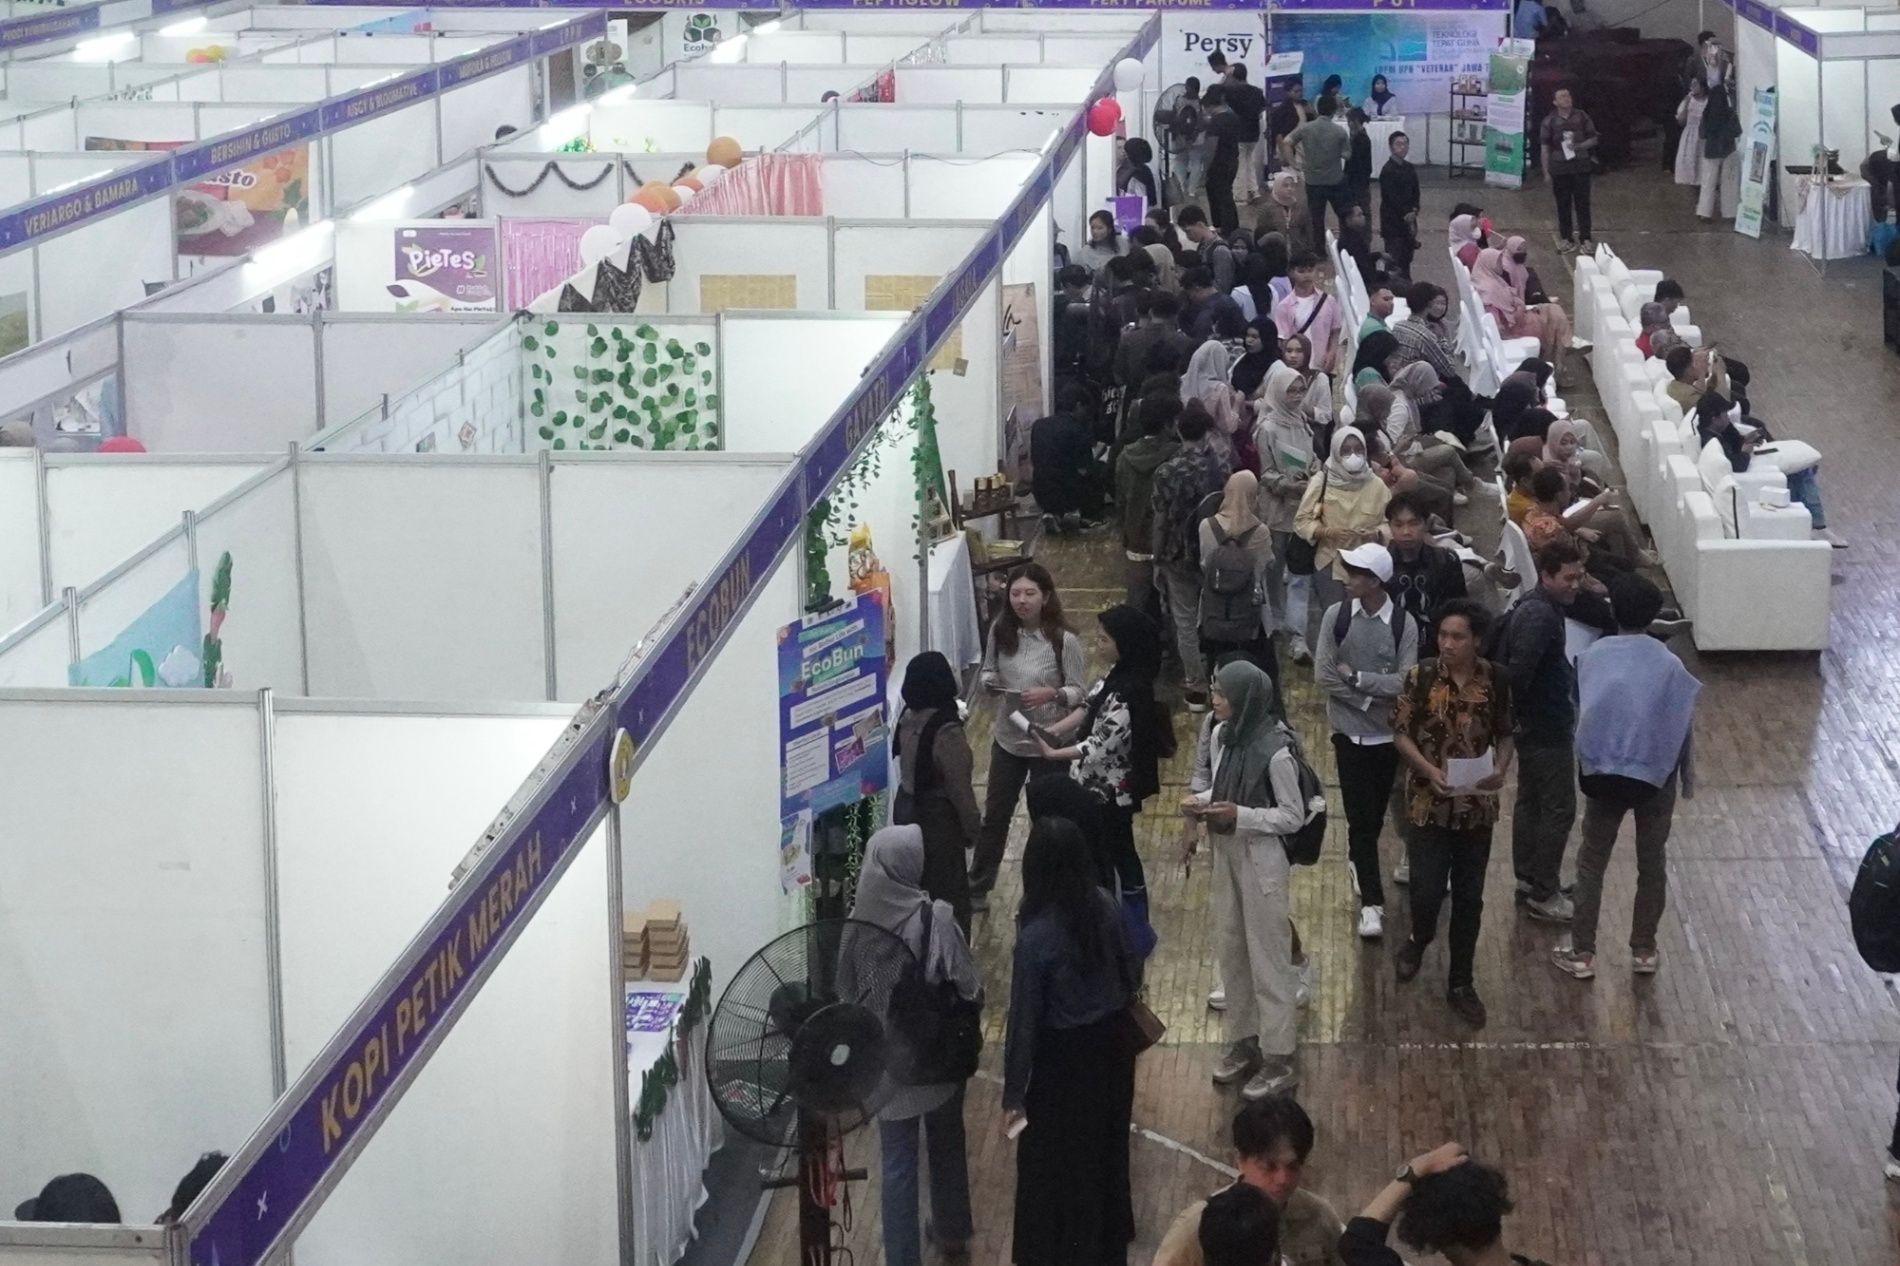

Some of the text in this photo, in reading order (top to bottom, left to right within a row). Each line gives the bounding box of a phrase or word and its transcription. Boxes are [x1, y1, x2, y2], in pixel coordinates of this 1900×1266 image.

[1184, 32, 1253, 59] Persy
[24, 200, 82, 237] VERIARGO
[686, 547, 750, 677] ECOBUN
[801, 643, 864, 680] EcoBun
[320, 829, 542, 1155] KOPI PETIK MERAH
